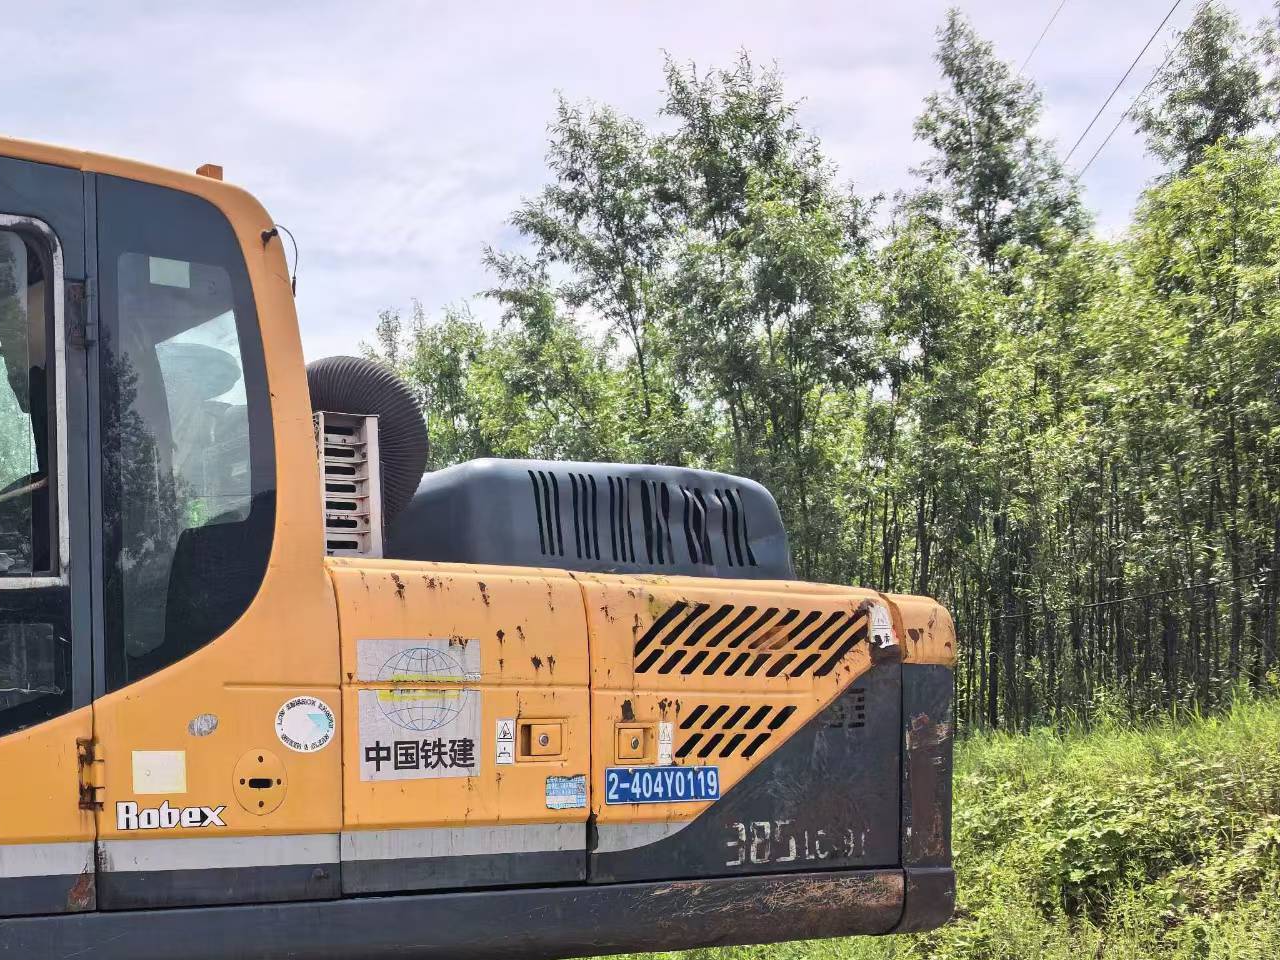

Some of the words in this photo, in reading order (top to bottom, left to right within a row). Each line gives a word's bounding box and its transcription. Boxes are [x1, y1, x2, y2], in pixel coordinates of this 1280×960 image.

[364, 738, 476, 772] 中国铁建
[607, 770, 718, 801] 2-404Y0119
[116, 800, 228, 831] Robex
